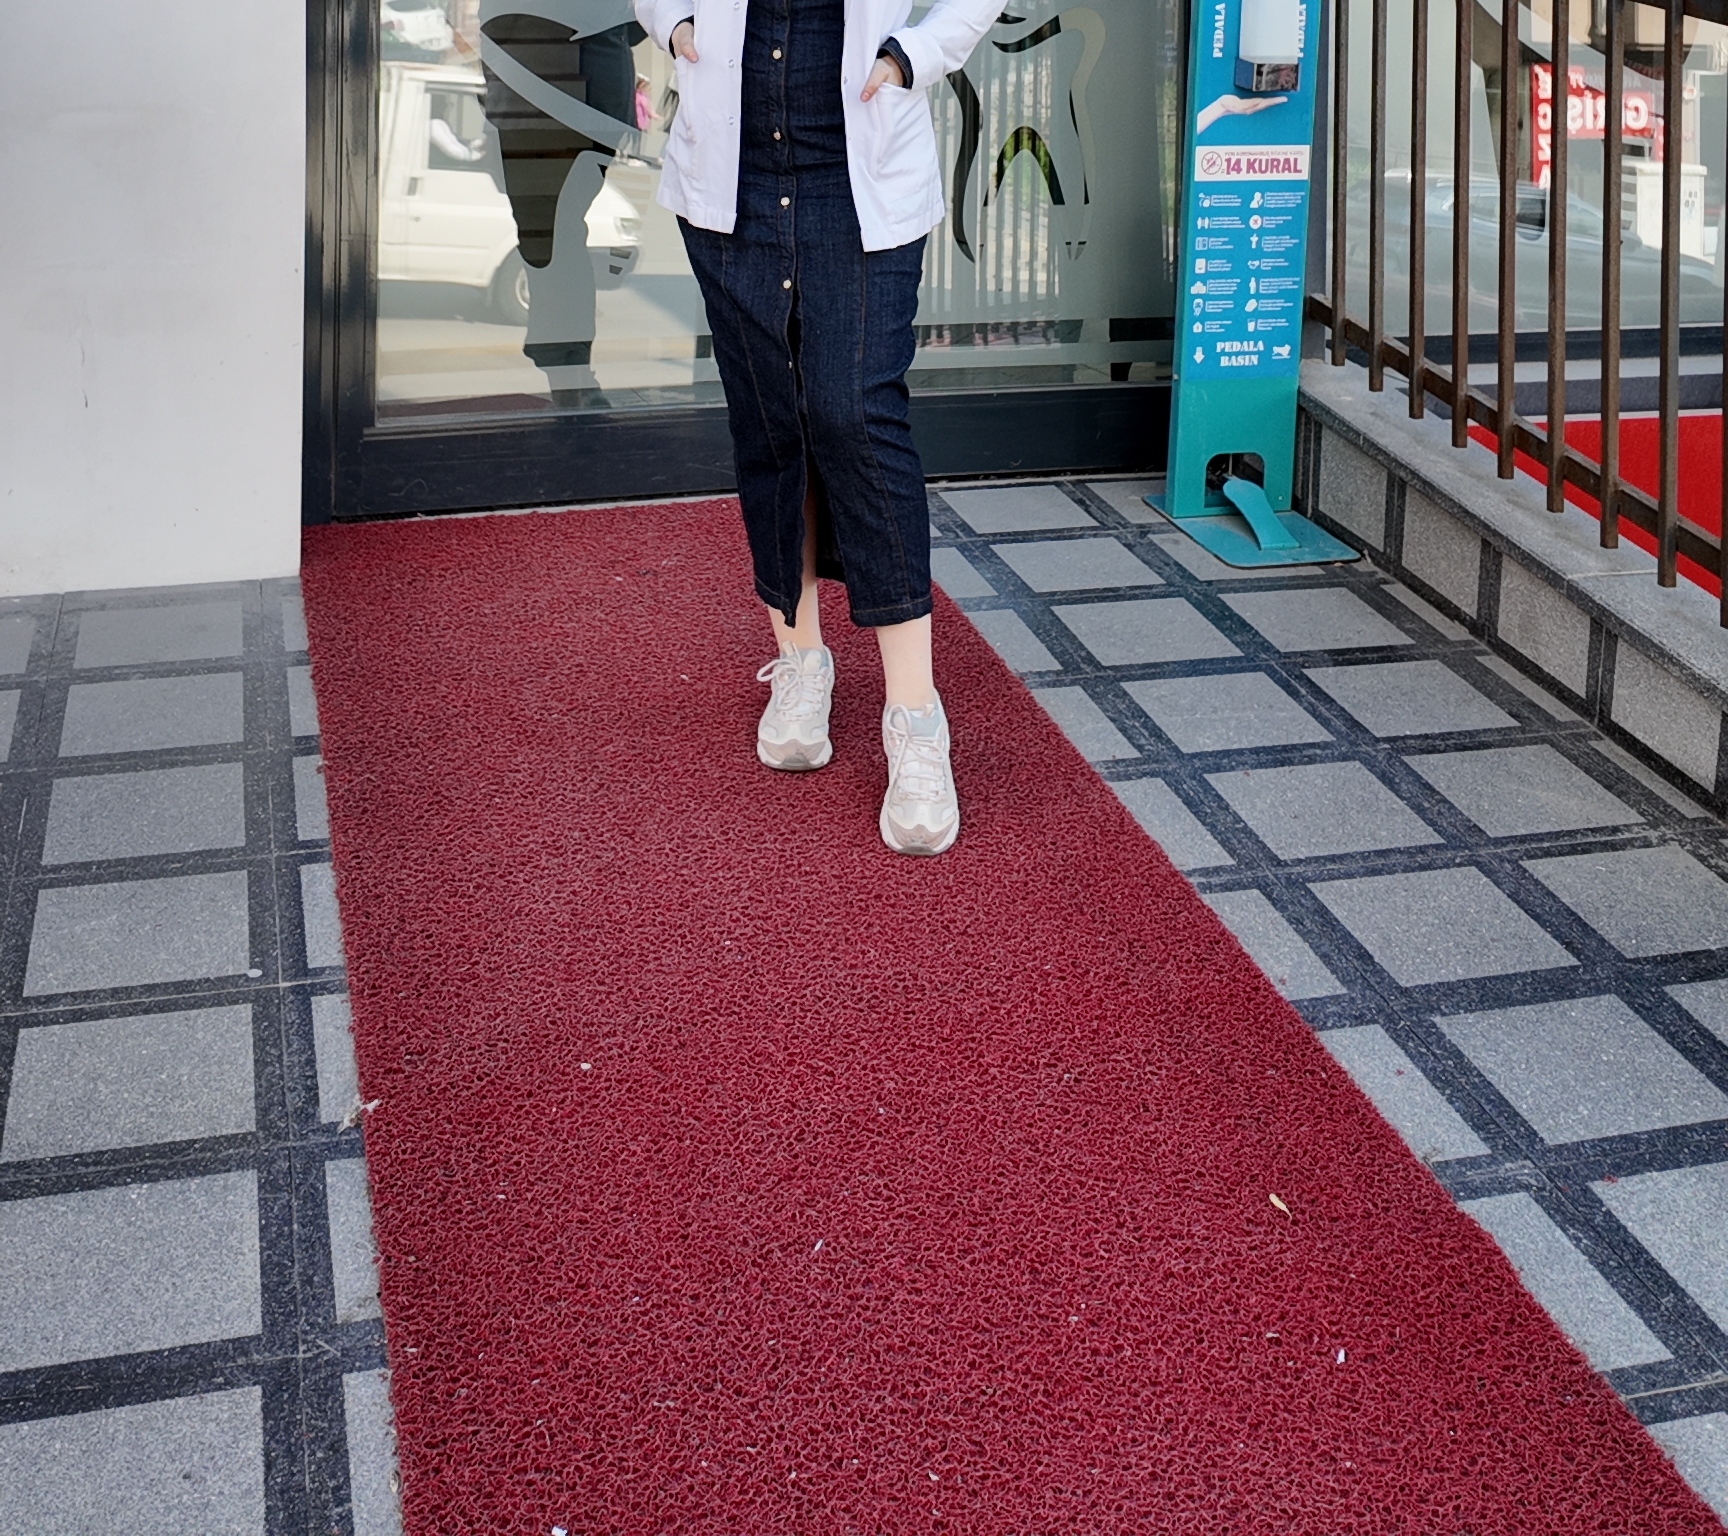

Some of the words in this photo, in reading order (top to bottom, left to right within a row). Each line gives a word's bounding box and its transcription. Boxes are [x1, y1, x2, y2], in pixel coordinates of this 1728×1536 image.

[1213, 1, 1226, 58] PEDALA
[1225, 157, 1243, 175] 14
[1246, 156, 1303, 175] KURAL
[1216, 340, 1265, 353] PEDALA
[1220, 354, 1259, 367] BASIN
